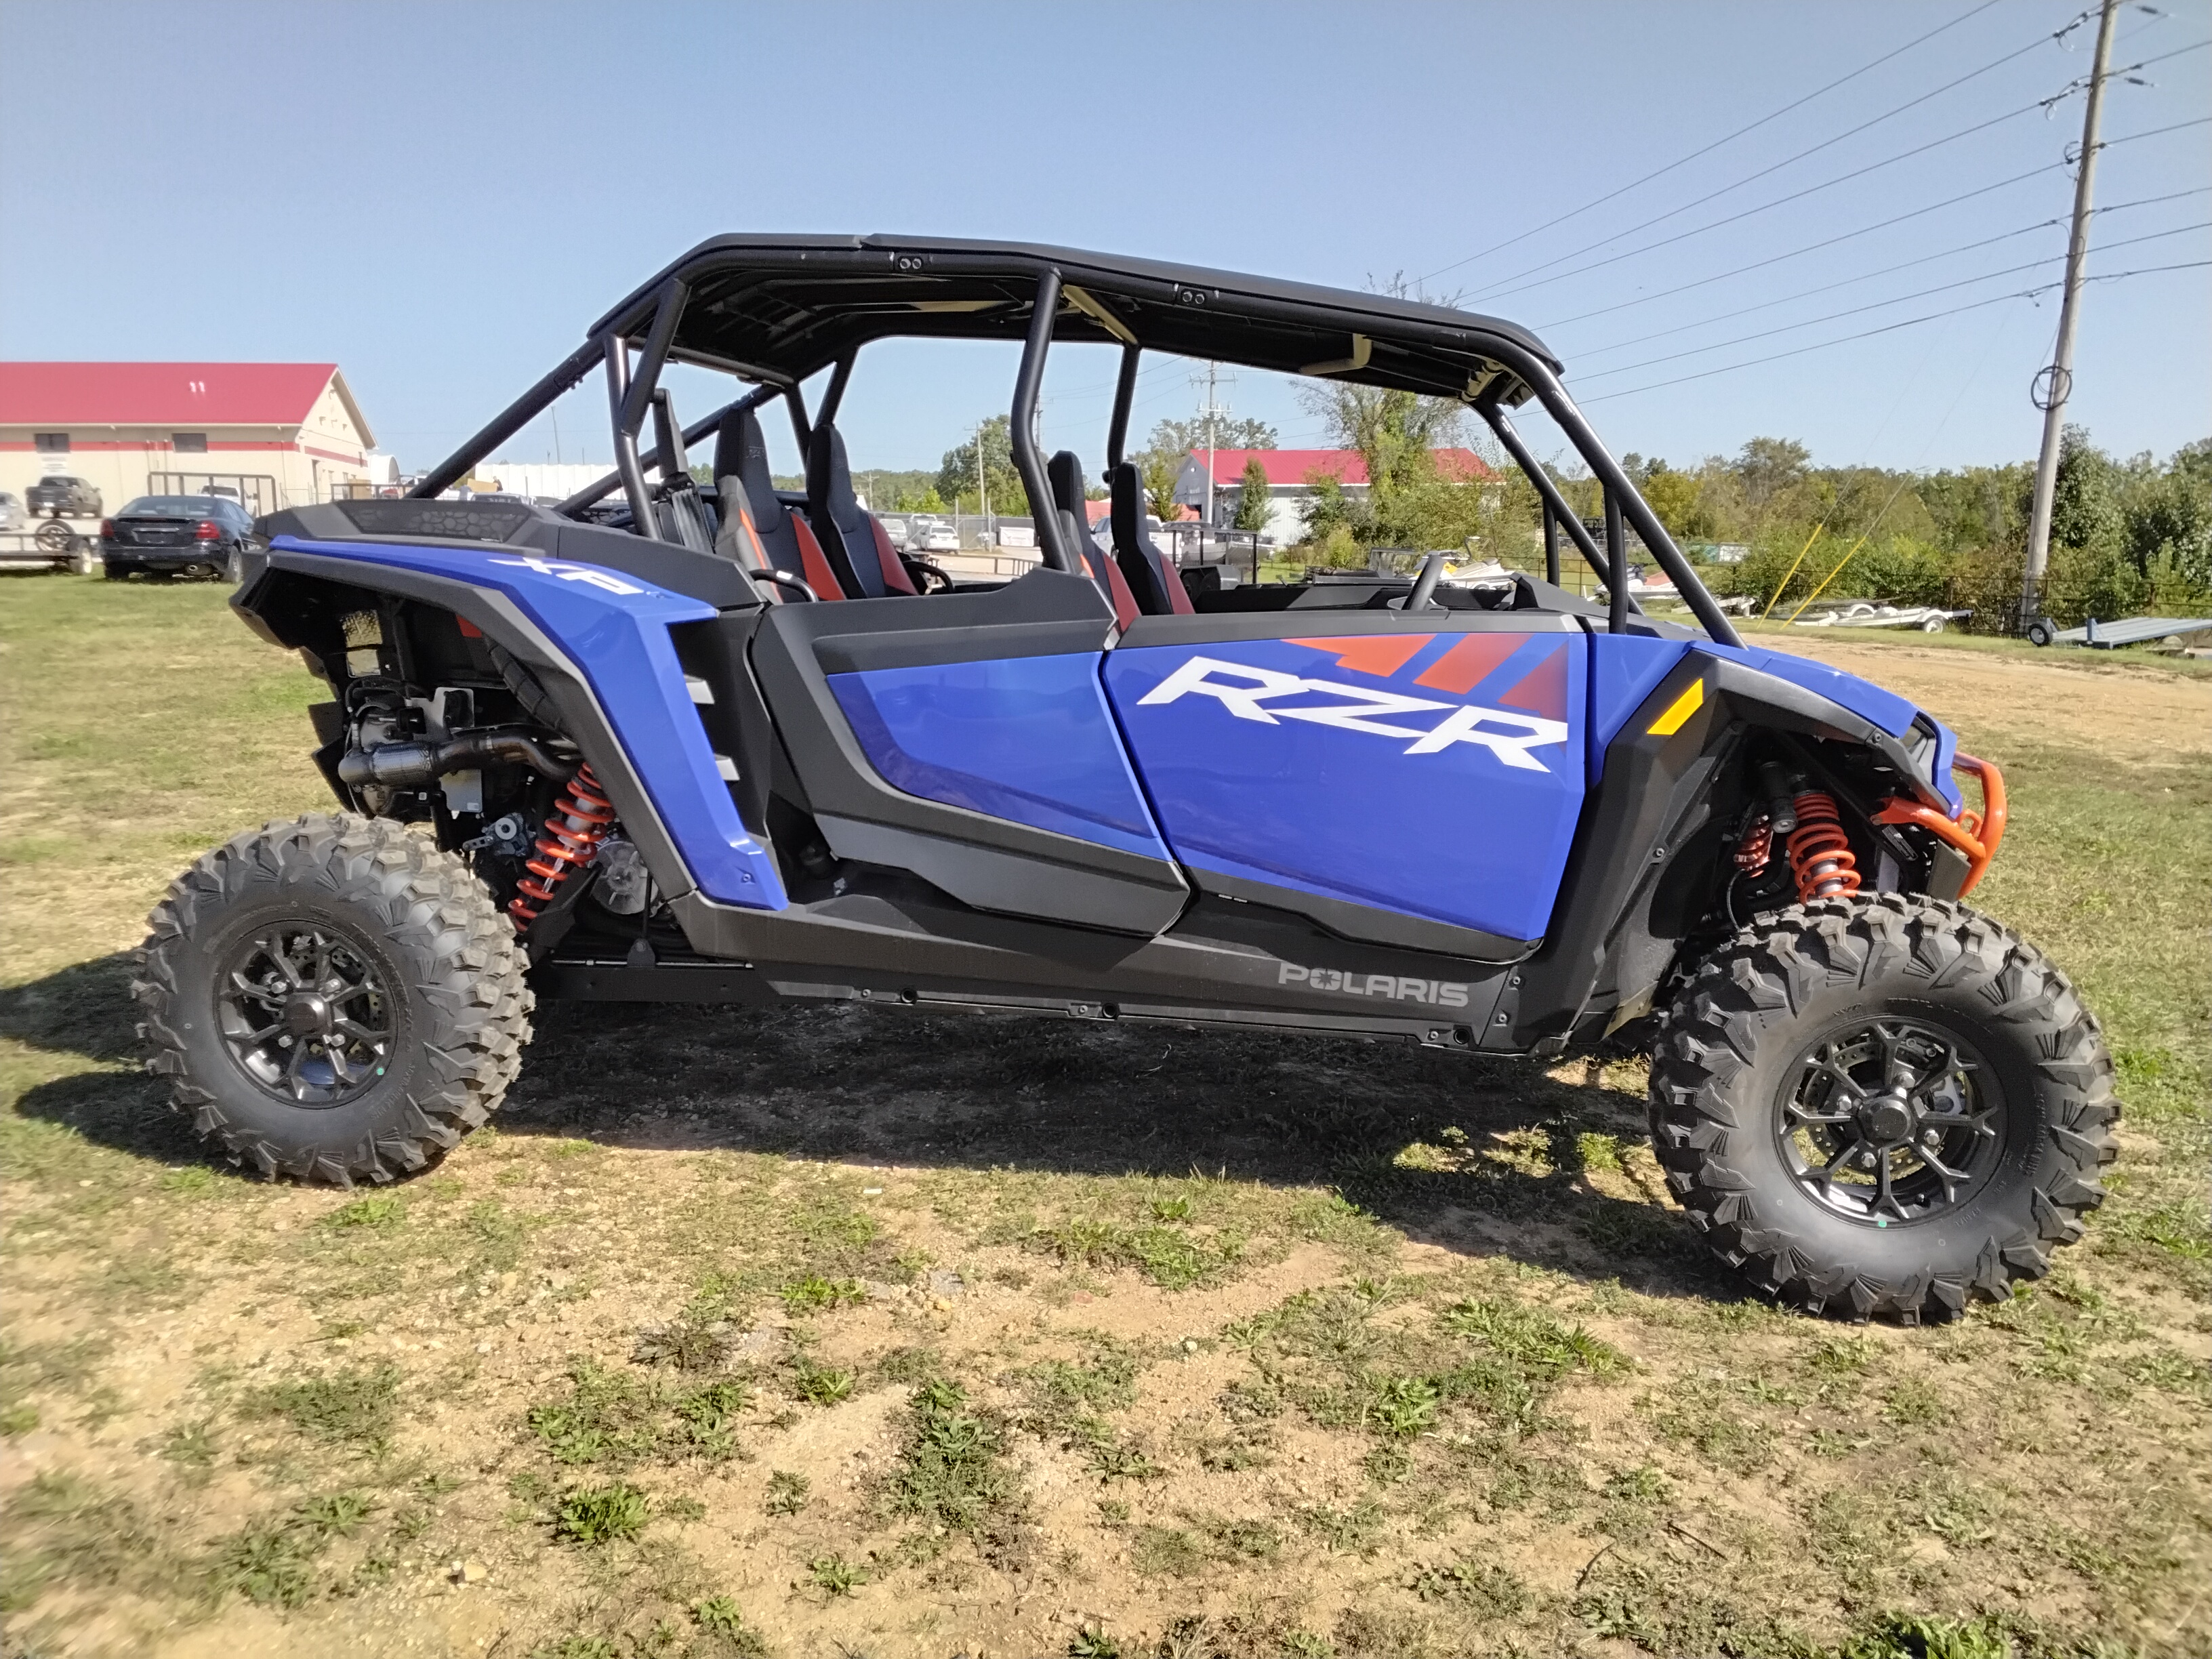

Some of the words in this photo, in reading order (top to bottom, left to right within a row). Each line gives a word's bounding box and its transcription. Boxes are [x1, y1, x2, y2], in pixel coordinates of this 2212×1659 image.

[486, 557, 644, 595] XP
[1137, 656, 1568, 773] RZR
[1278, 962, 1469, 1008] POLARIS
